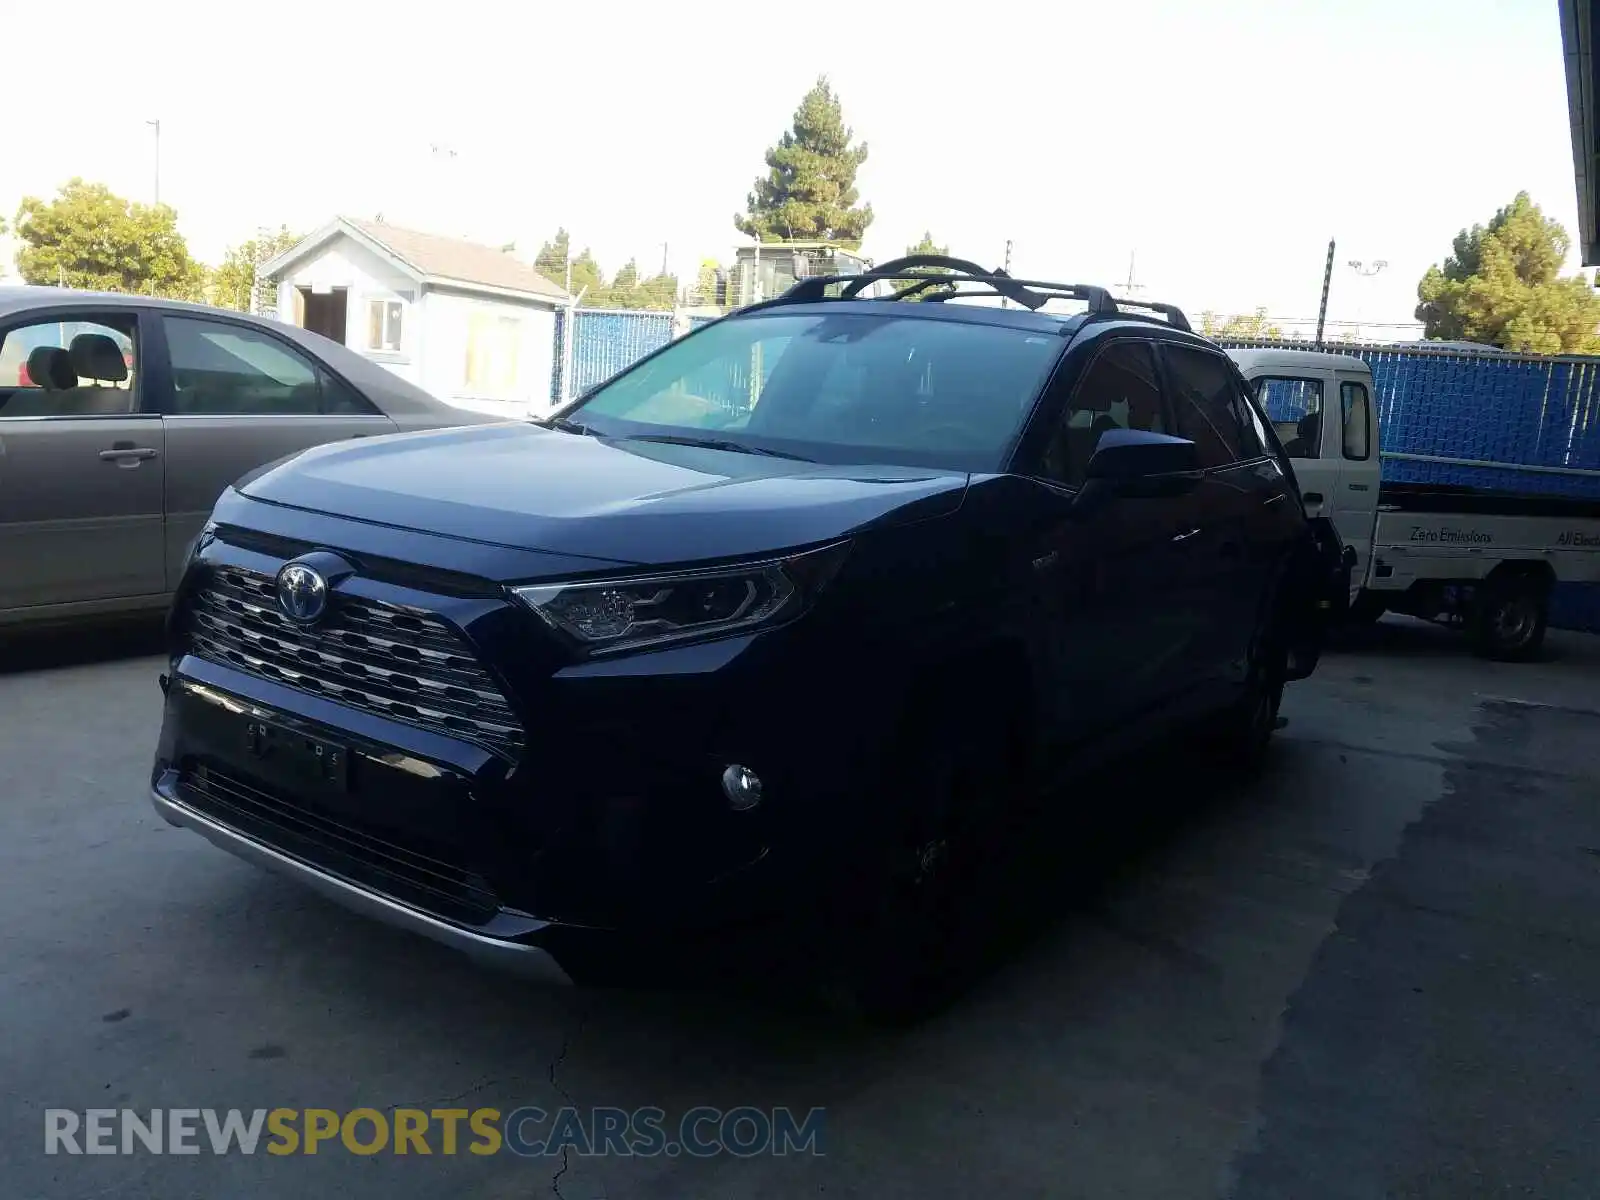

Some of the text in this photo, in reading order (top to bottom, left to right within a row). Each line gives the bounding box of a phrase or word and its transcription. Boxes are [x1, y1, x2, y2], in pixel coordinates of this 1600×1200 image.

[1410, 526, 1493, 543] Zero Emissions
[1556, 531, 1573, 545] All
